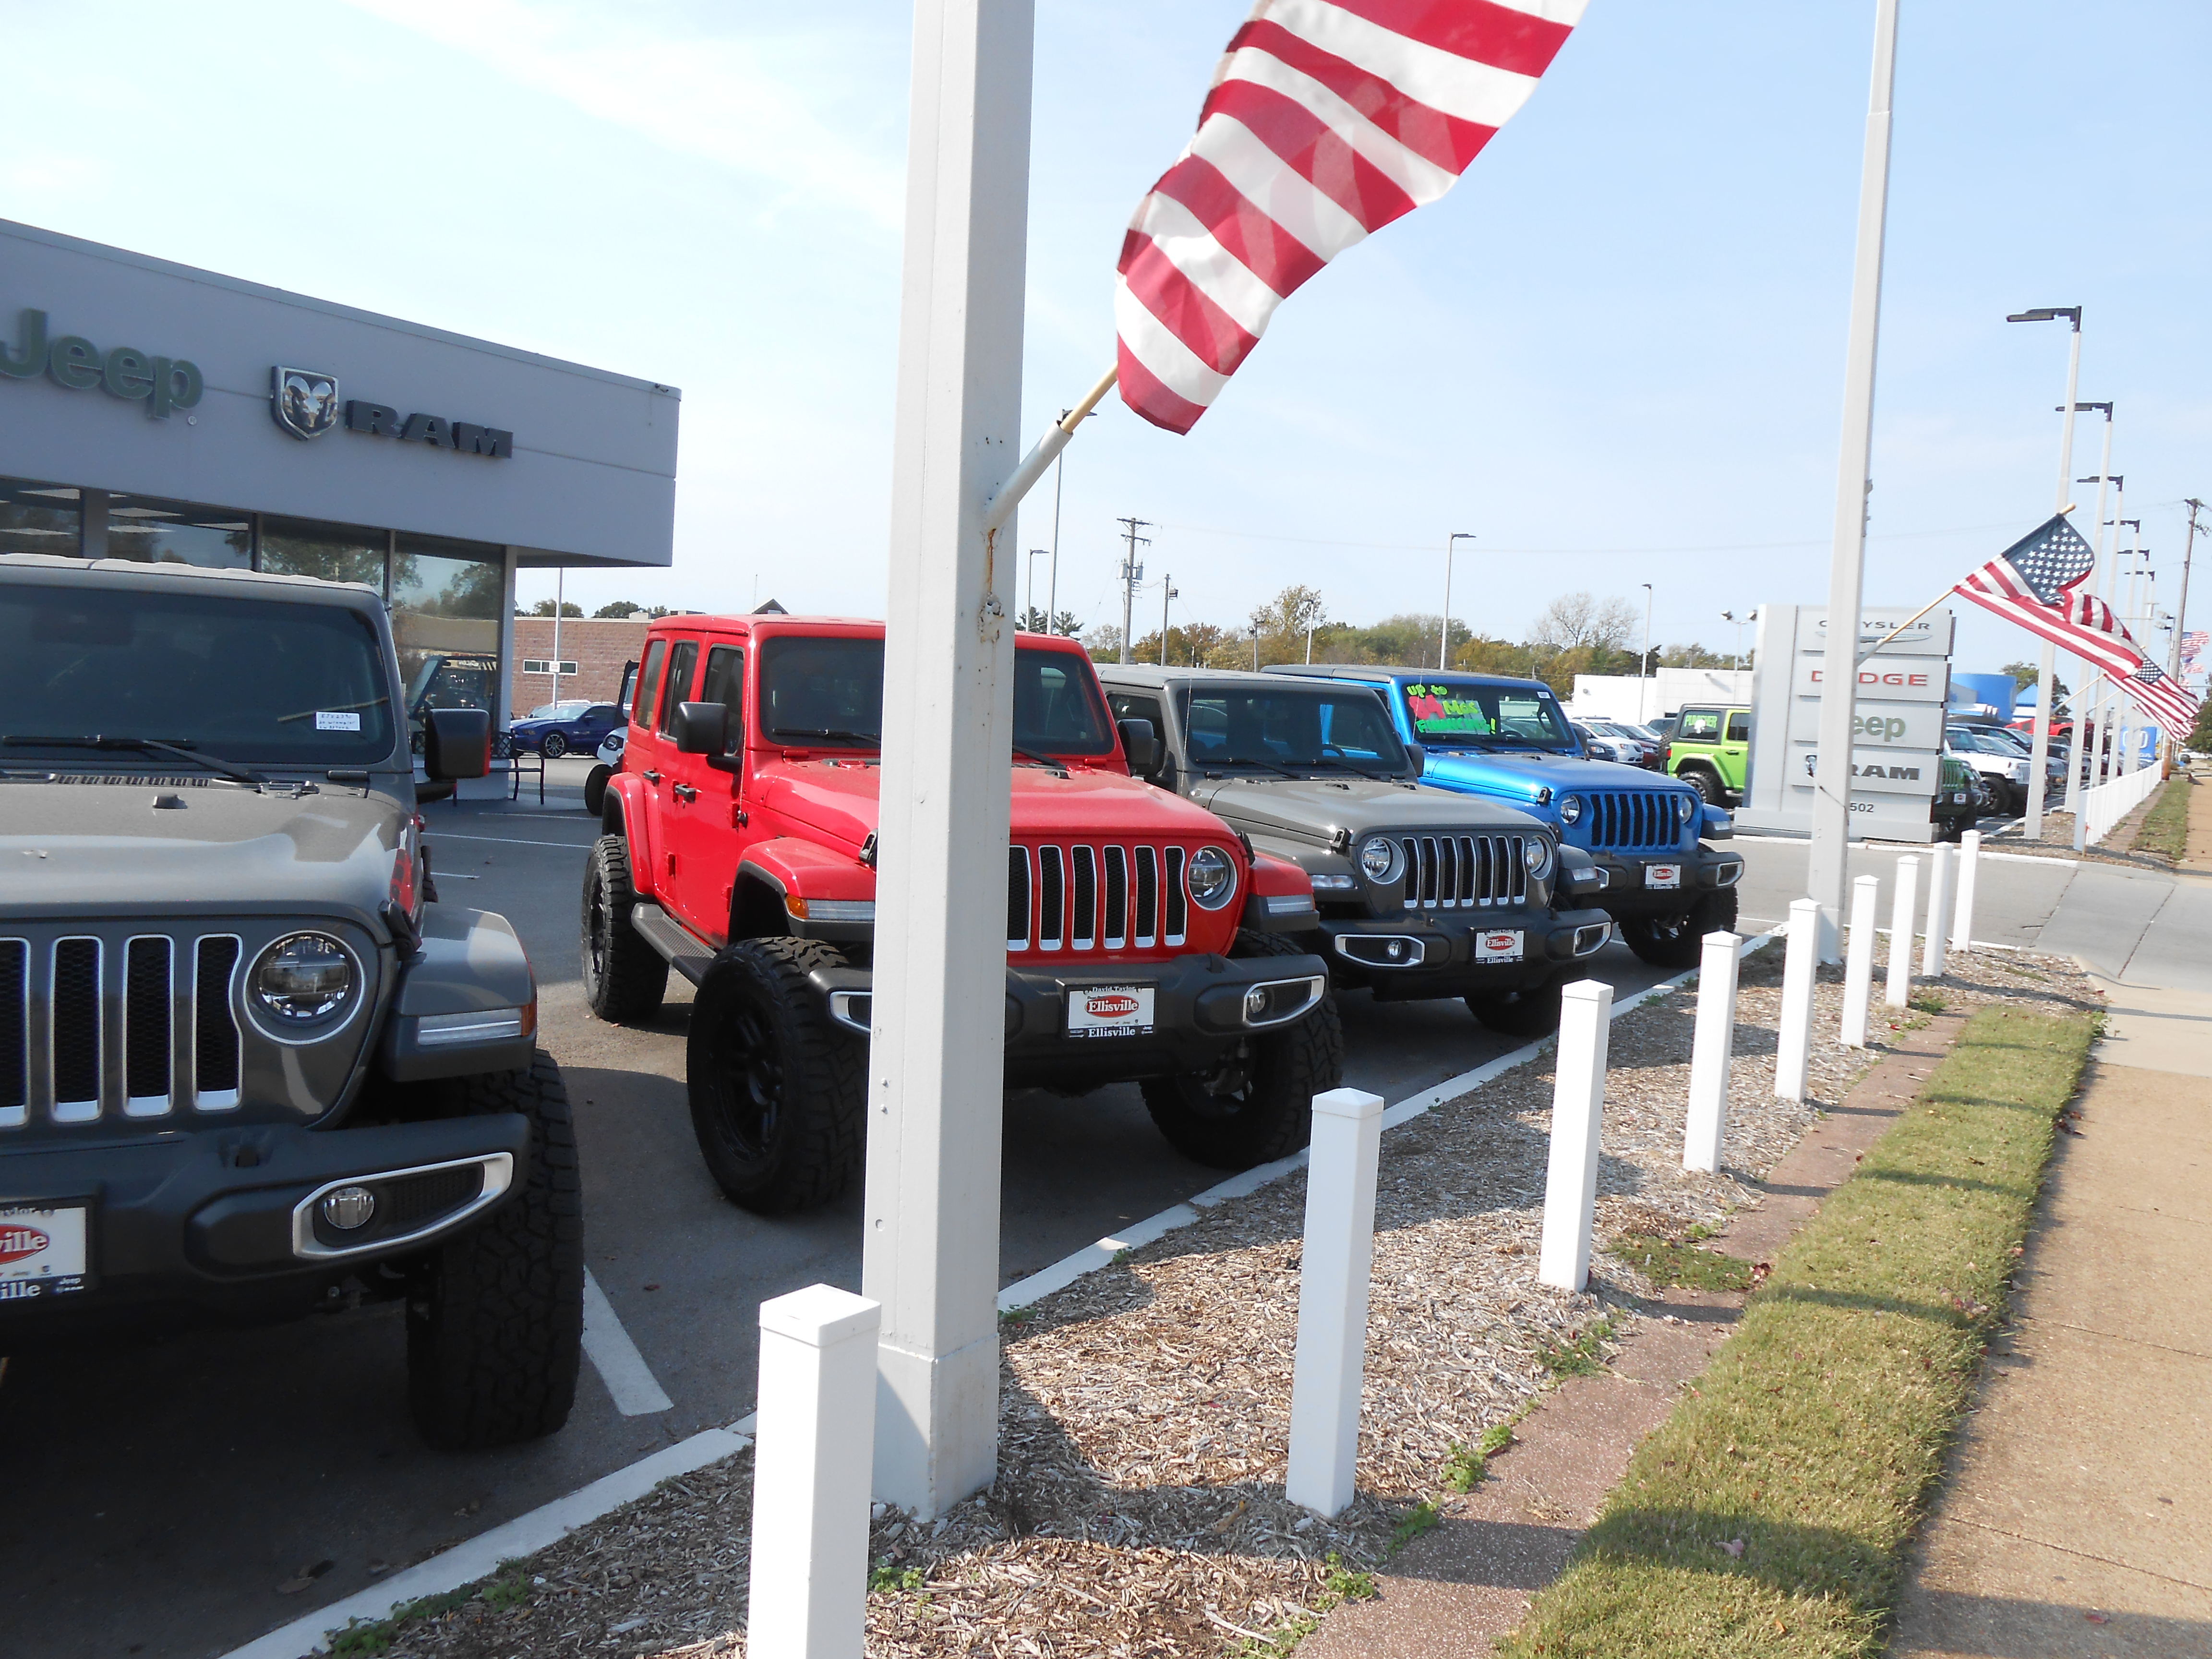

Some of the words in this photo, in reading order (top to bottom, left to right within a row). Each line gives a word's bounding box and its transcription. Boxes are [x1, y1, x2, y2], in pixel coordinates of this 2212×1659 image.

[0, 308, 204, 420] Jeep
[345, 399, 513, 459] RAM
[1819, 620, 1931, 630] CYSLER
[1811, 671, 1928, 686] DDGE
[1431, 685, 1448, 695] to
[1442, 700, 1479, 715] Mos
[1854, 715, 1906, 742] eep
[1851, 764, 1919, 780] AM
[1487, 938, 1515, 947] Ellisville
[1088, 999, 1138, 1013] Ellisville
[1088, 1026, 1136, 1038] Ellisville
